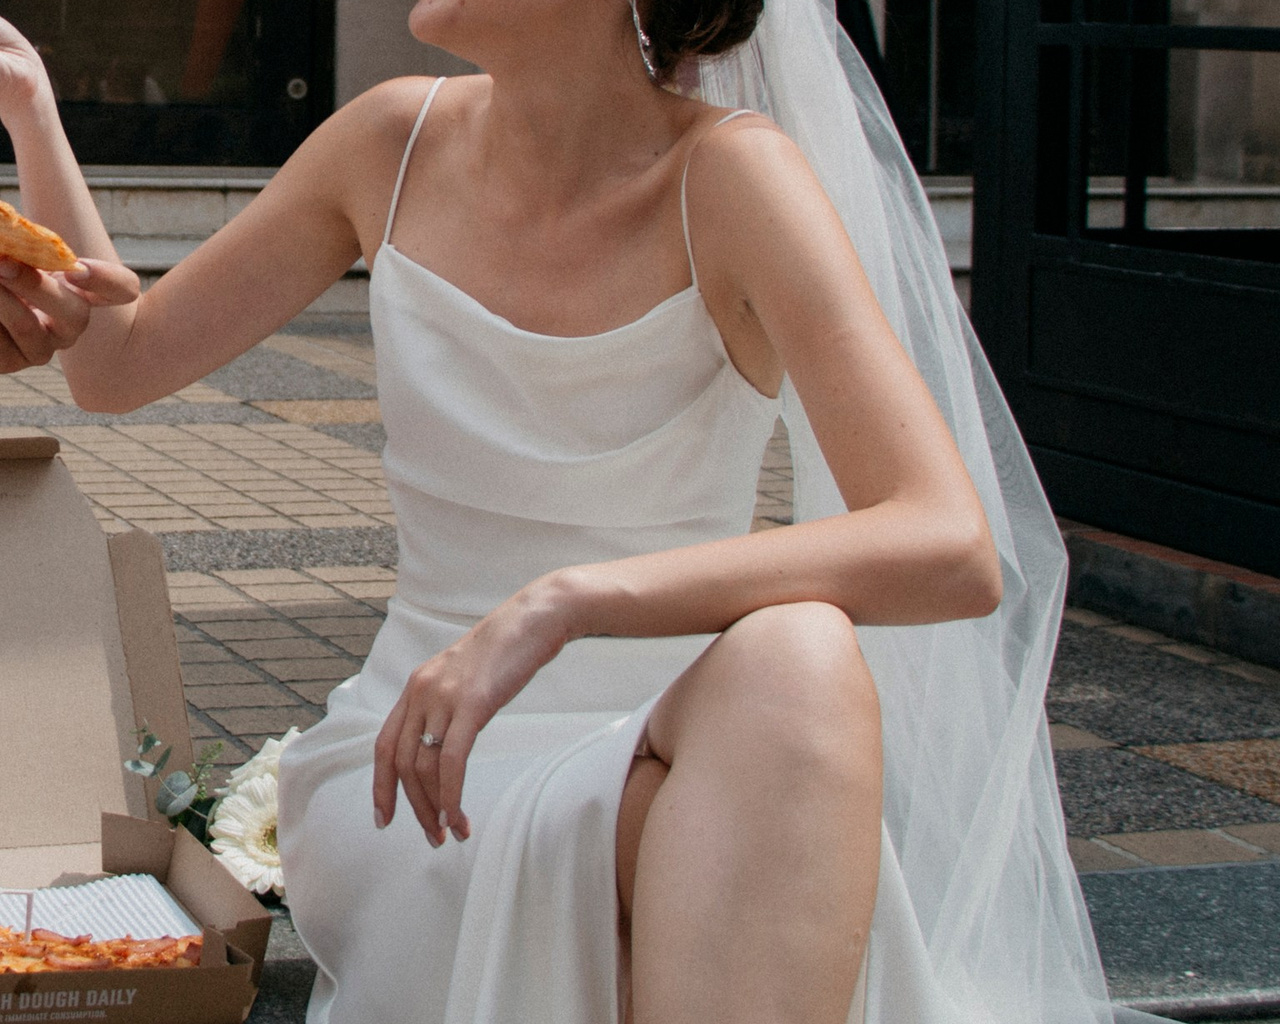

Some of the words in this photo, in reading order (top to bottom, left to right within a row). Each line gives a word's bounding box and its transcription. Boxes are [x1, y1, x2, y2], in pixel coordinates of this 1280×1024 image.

[18, 990, 81, 1010] DOUGH
[86, 988, 137, 1007] DAILY
[5, 1012, 49, 1023] IMMEDIATE
